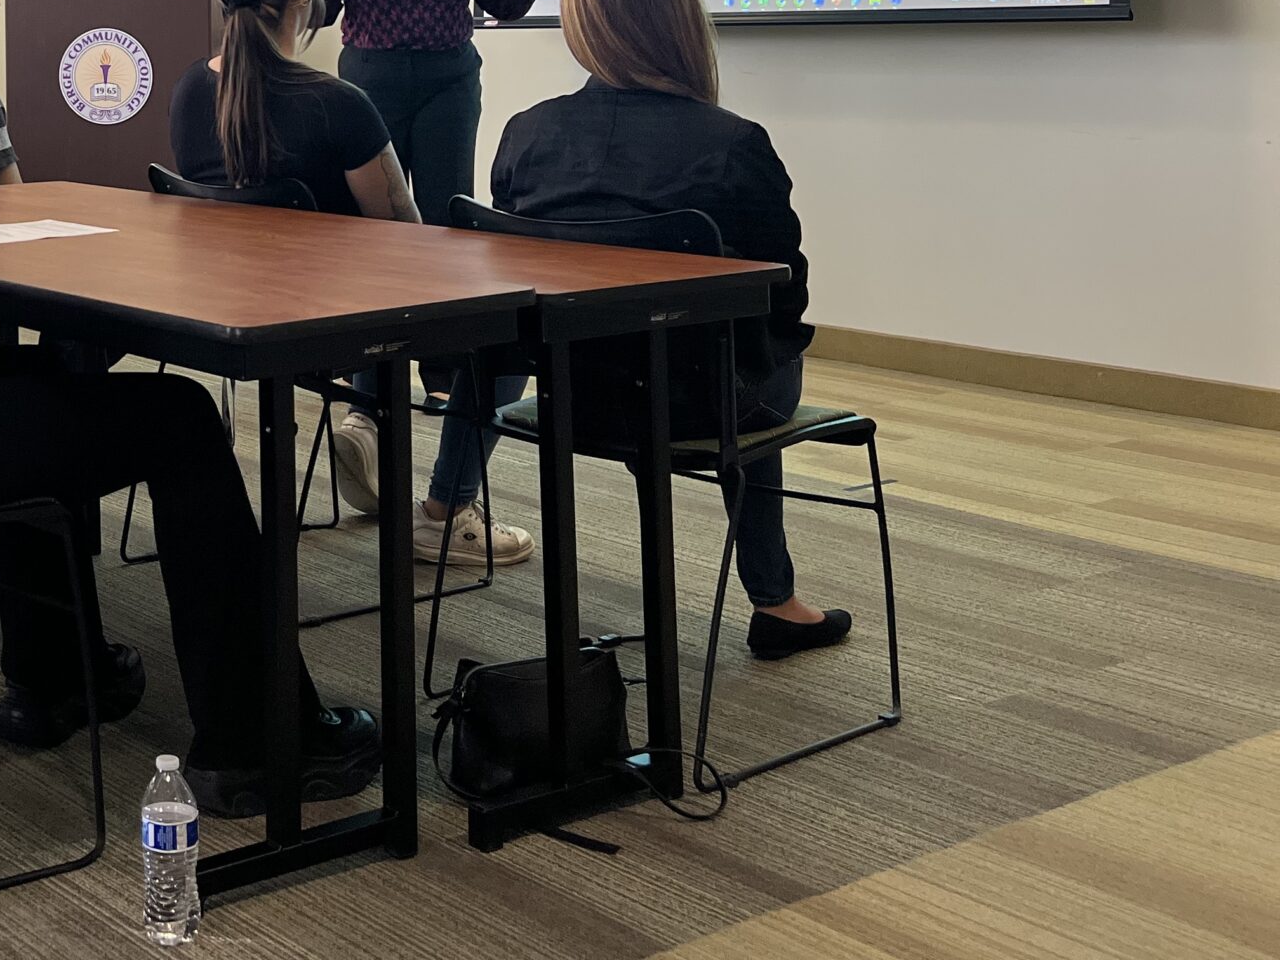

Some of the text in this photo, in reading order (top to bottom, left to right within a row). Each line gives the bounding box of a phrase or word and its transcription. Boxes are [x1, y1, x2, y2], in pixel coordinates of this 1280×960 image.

[63, 32, 149, 112] BERGEN COMMUNITY COLLEGE
